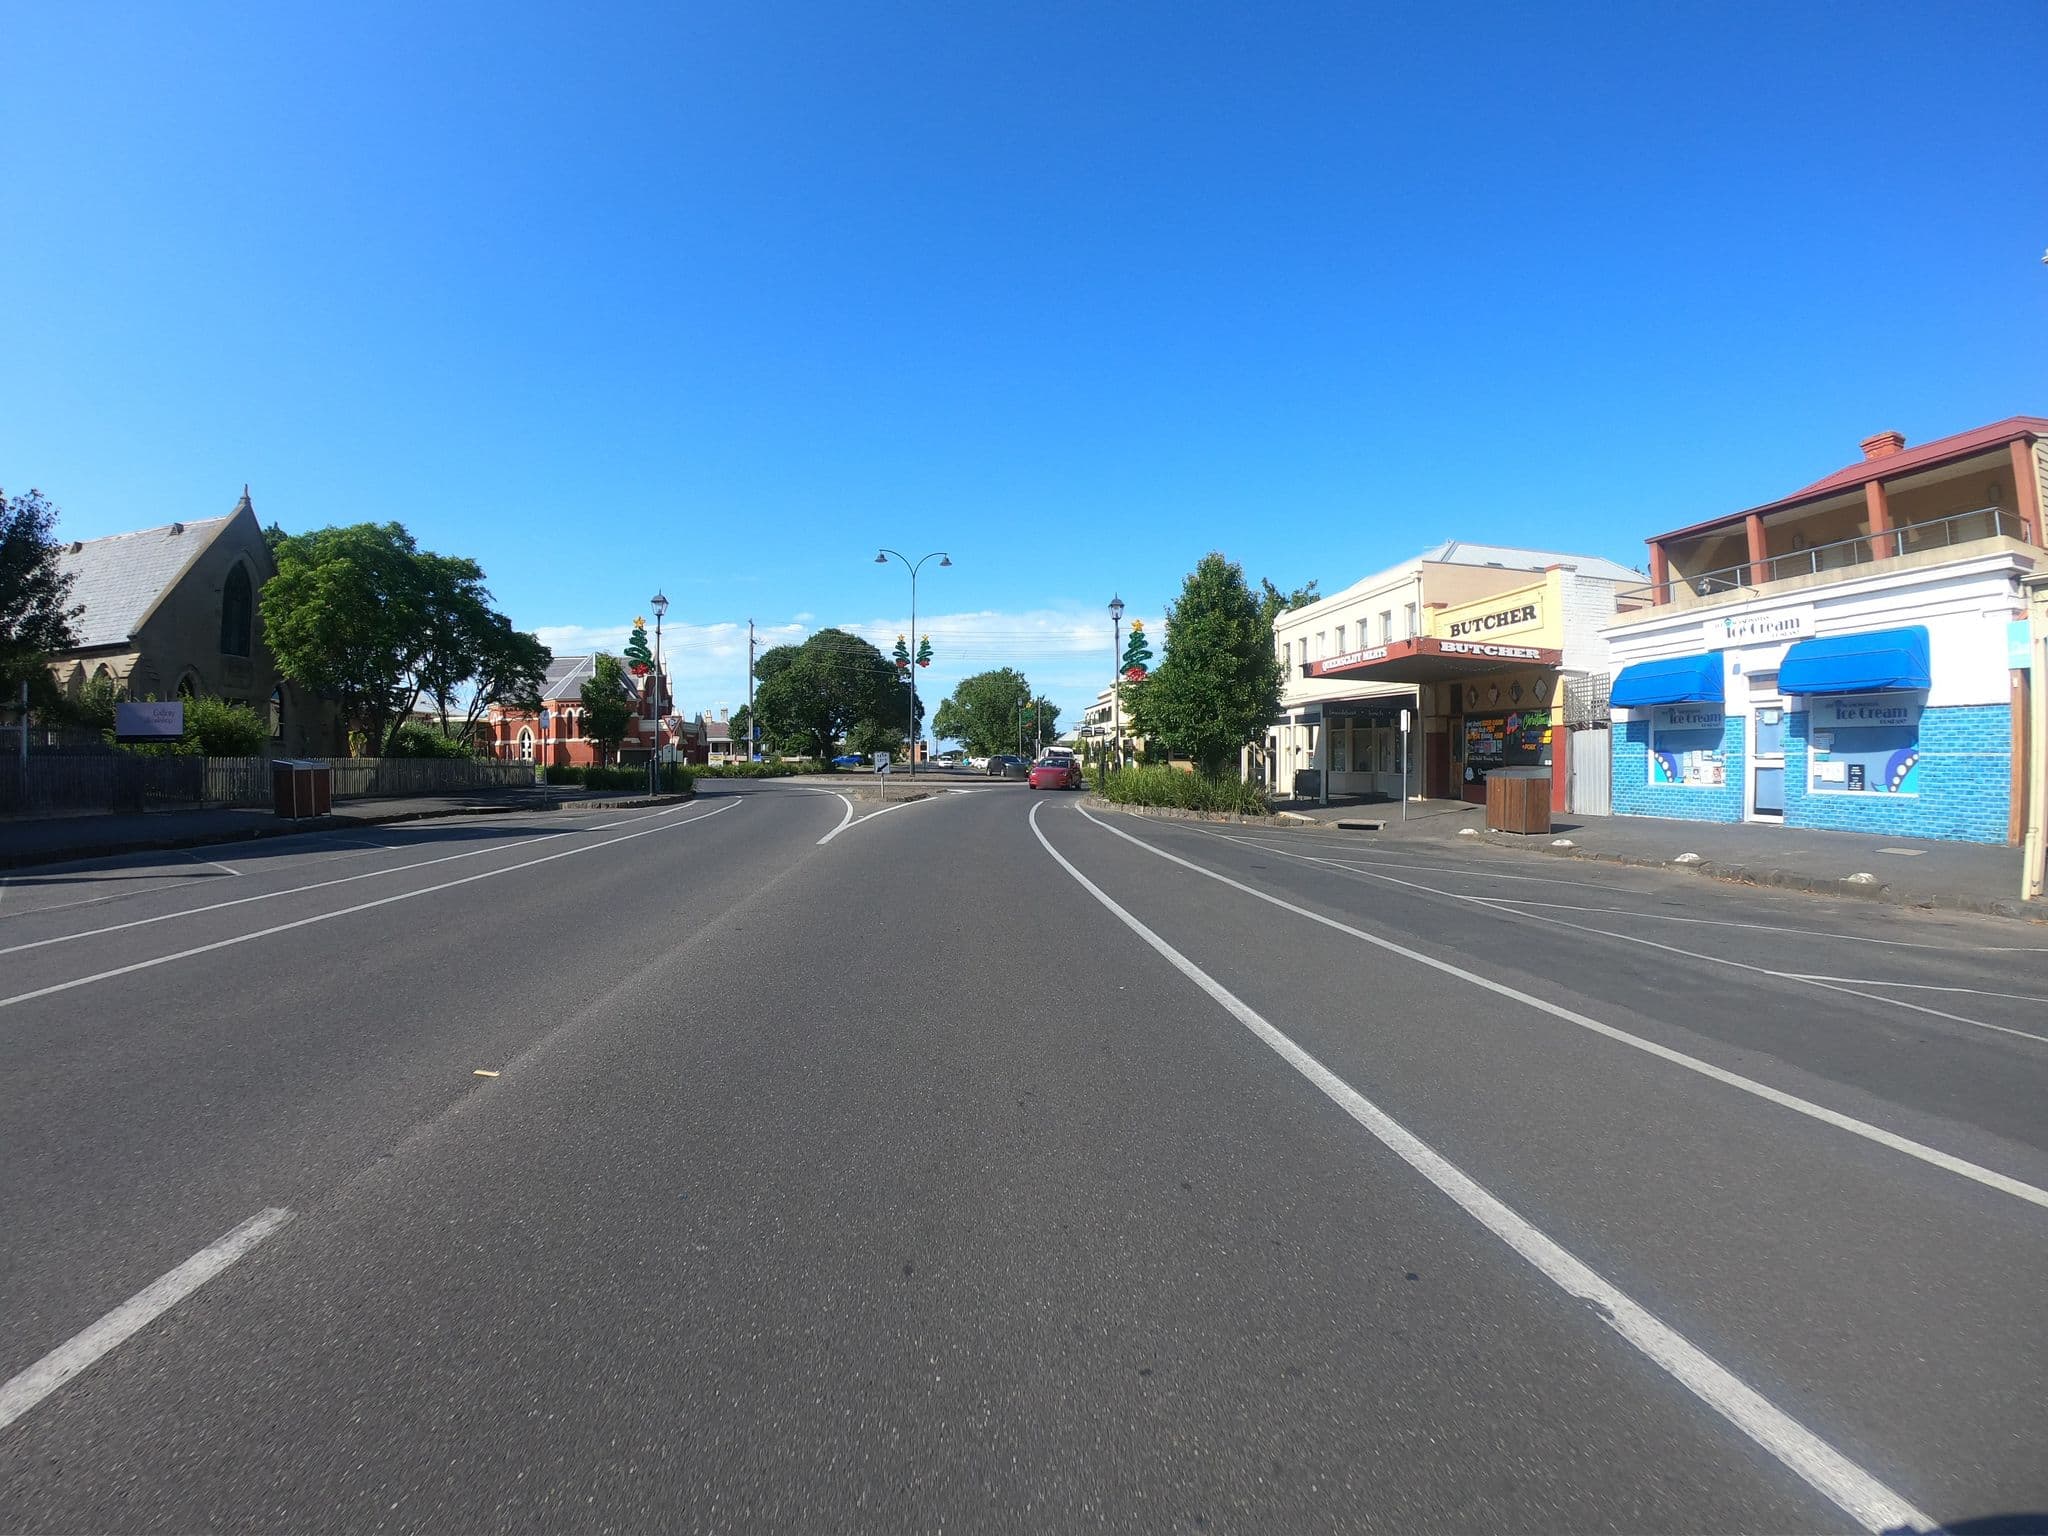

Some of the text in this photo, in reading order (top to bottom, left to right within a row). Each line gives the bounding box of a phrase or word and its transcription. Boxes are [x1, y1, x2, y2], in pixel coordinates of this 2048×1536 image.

[1450, 605, 1537, 637] BUTCHER
[1726, 625, 1746, 639] Ice
[1750, 618, 1800, 635] Cream
[1440, 641, 1540, 660] BUTCHER
[1669, 713, 1721, 725] Ice Cream
[1836, 707, 1908, 720] Ice Cream
